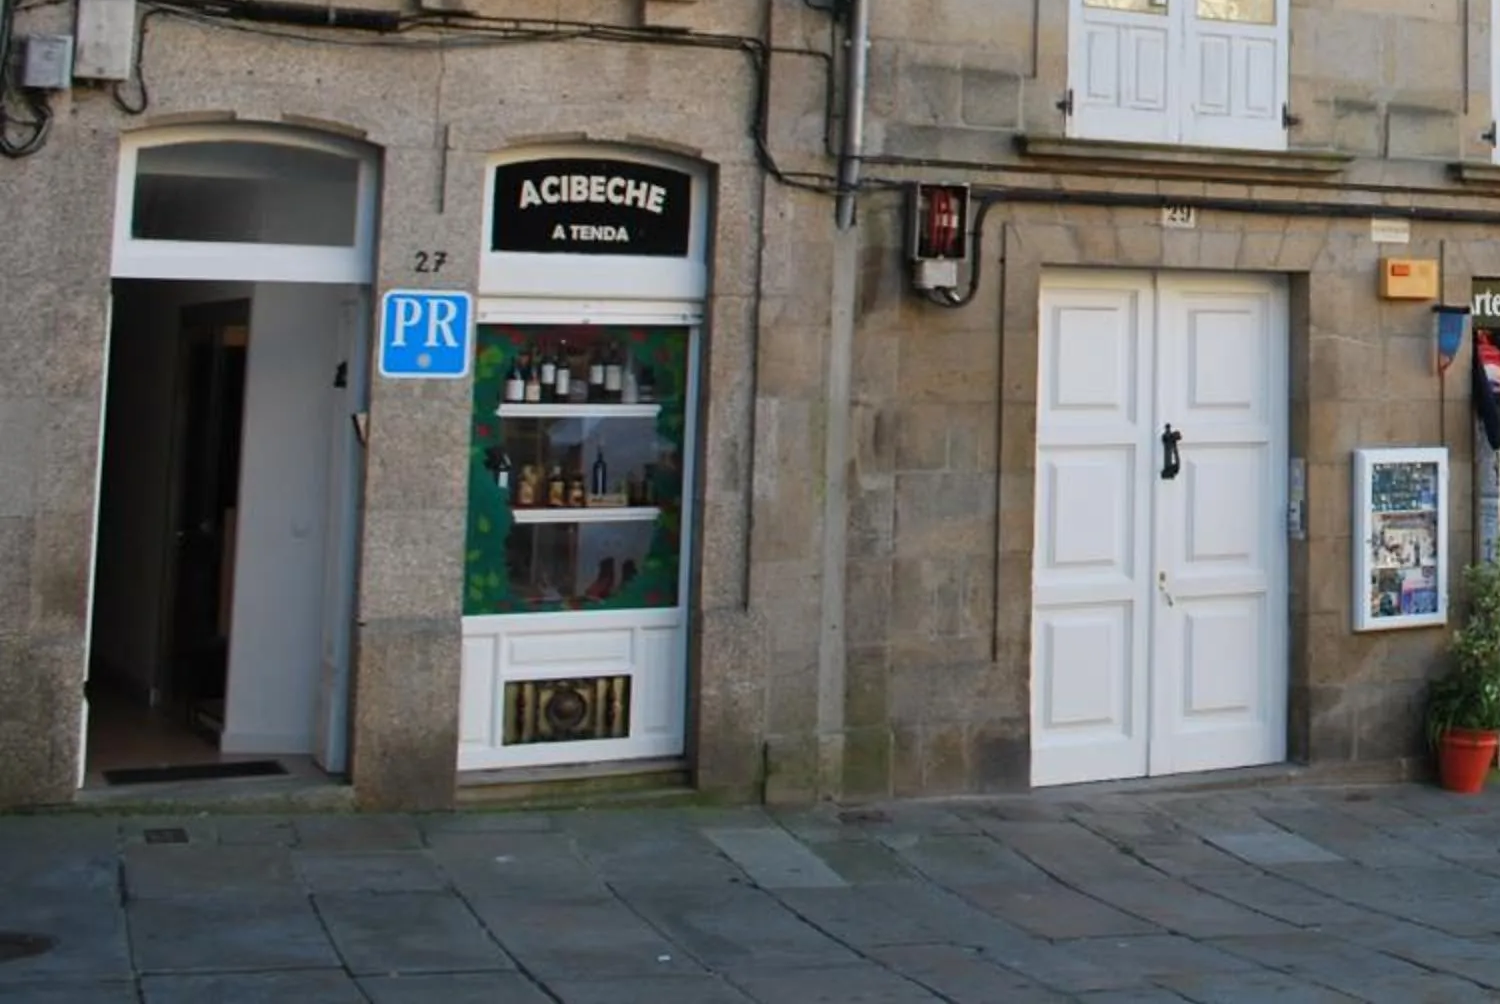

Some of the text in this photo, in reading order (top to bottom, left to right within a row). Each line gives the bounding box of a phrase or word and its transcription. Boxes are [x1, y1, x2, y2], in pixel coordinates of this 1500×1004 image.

[518, 175, 667, 214] ACIBECHE
[551, 225, 629, 242] A TENDA
[414, 251, 449, 273] 27
[390, 297, 459, 348] PR
